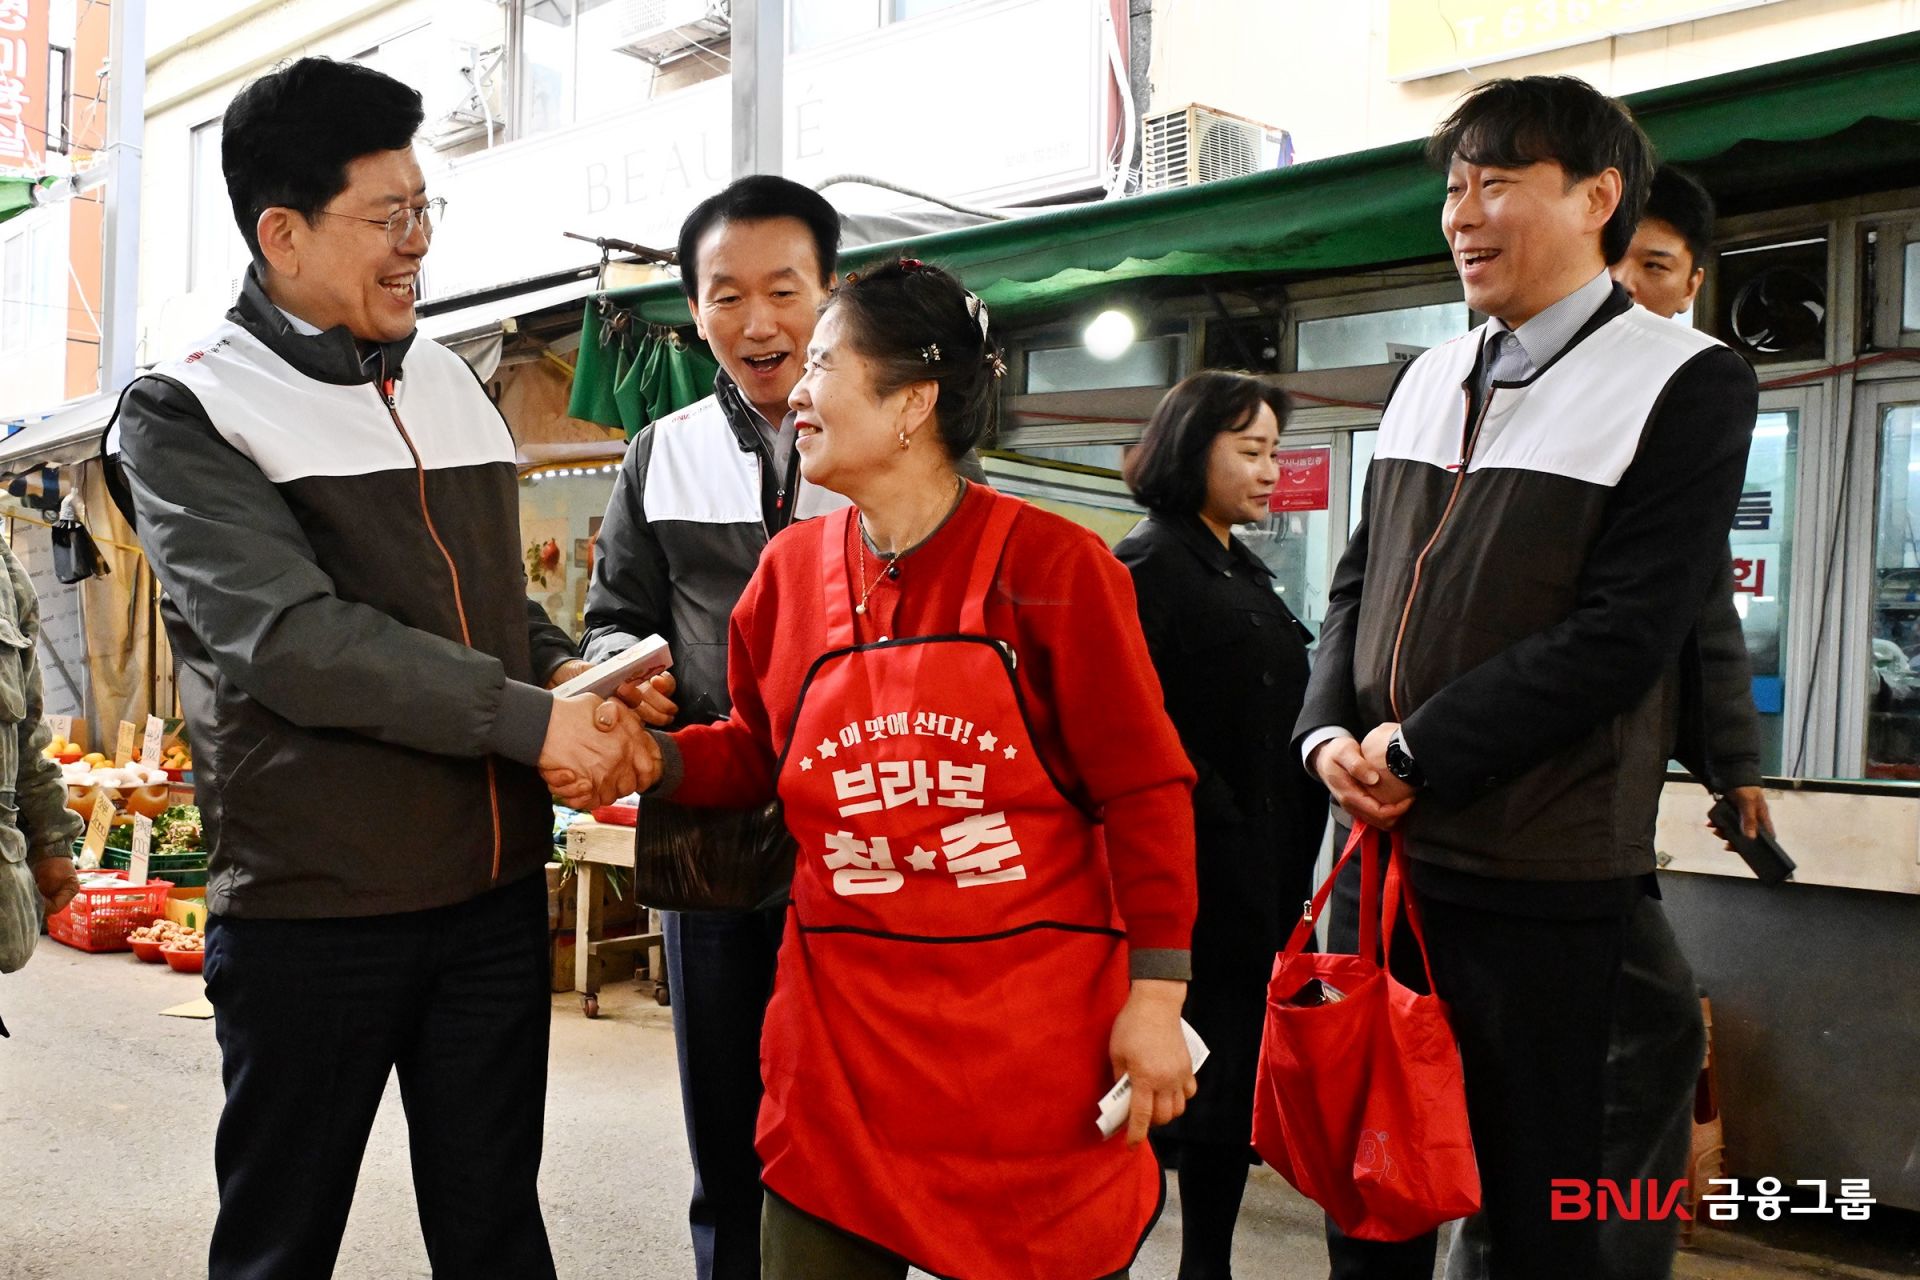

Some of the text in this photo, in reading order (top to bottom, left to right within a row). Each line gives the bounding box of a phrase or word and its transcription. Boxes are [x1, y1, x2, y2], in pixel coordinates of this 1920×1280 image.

[586, 84, 825, 215] BEAUÉ
[839, 712, 974, 748] 이 맛에 산다!
[832, 760, 986, 818] 브라보
